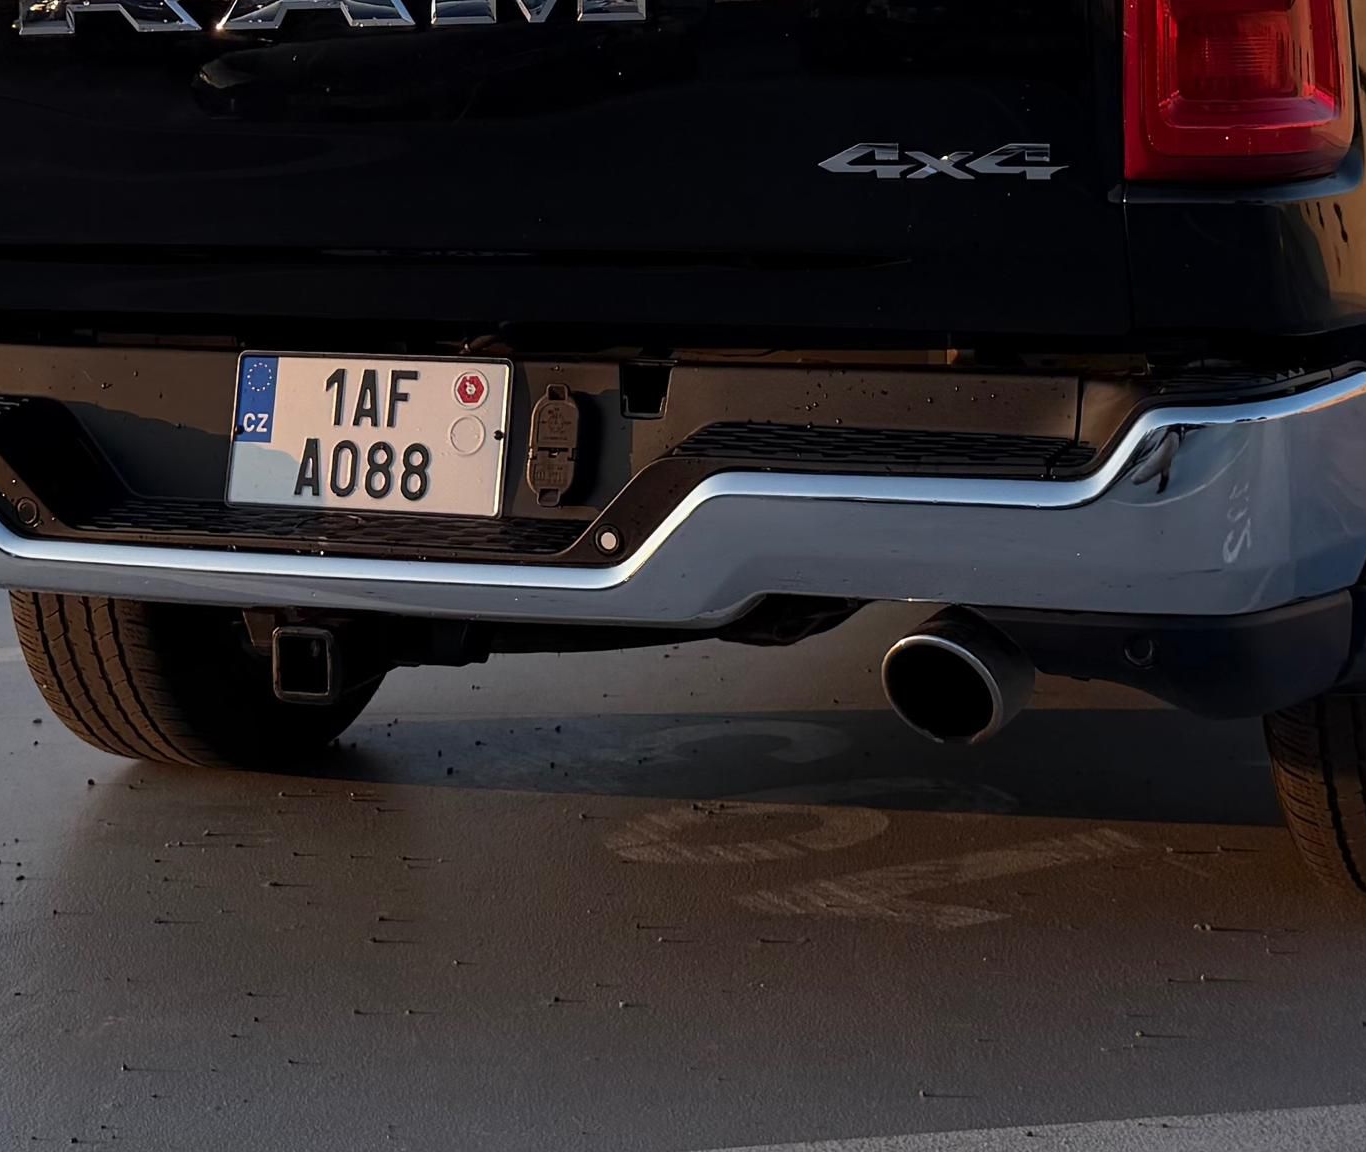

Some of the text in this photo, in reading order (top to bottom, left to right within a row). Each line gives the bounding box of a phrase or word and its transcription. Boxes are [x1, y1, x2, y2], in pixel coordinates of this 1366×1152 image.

[242, 412, 270, 434] CZ
[325, 367, 419, 428] 1AF
[293, 437, 431, 502] A088
